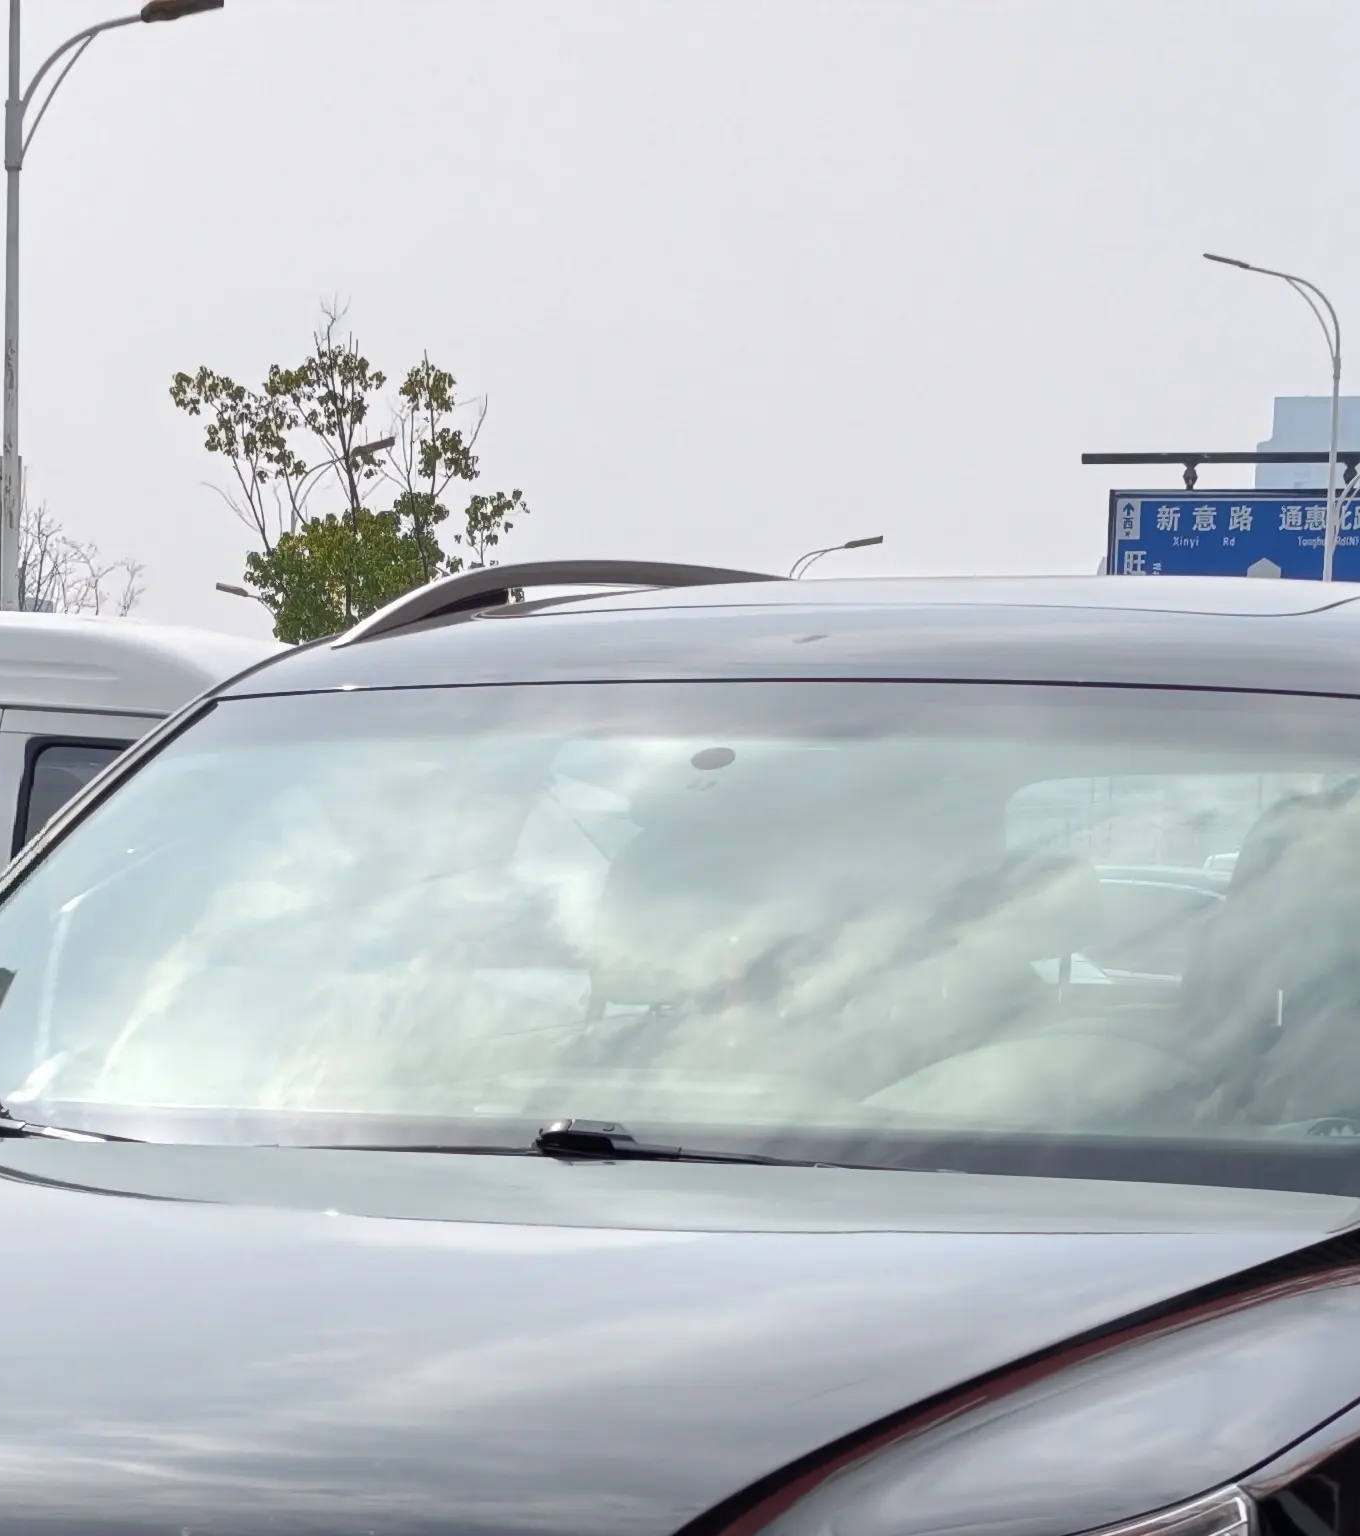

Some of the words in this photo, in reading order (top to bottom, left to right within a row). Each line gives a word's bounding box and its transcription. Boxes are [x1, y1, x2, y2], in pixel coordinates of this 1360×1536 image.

[1156, 504, 1253, 532] 新意路
[1172, 536, 1200, 549] Xinyi
[1222, 536, 1236, 547] Rd
